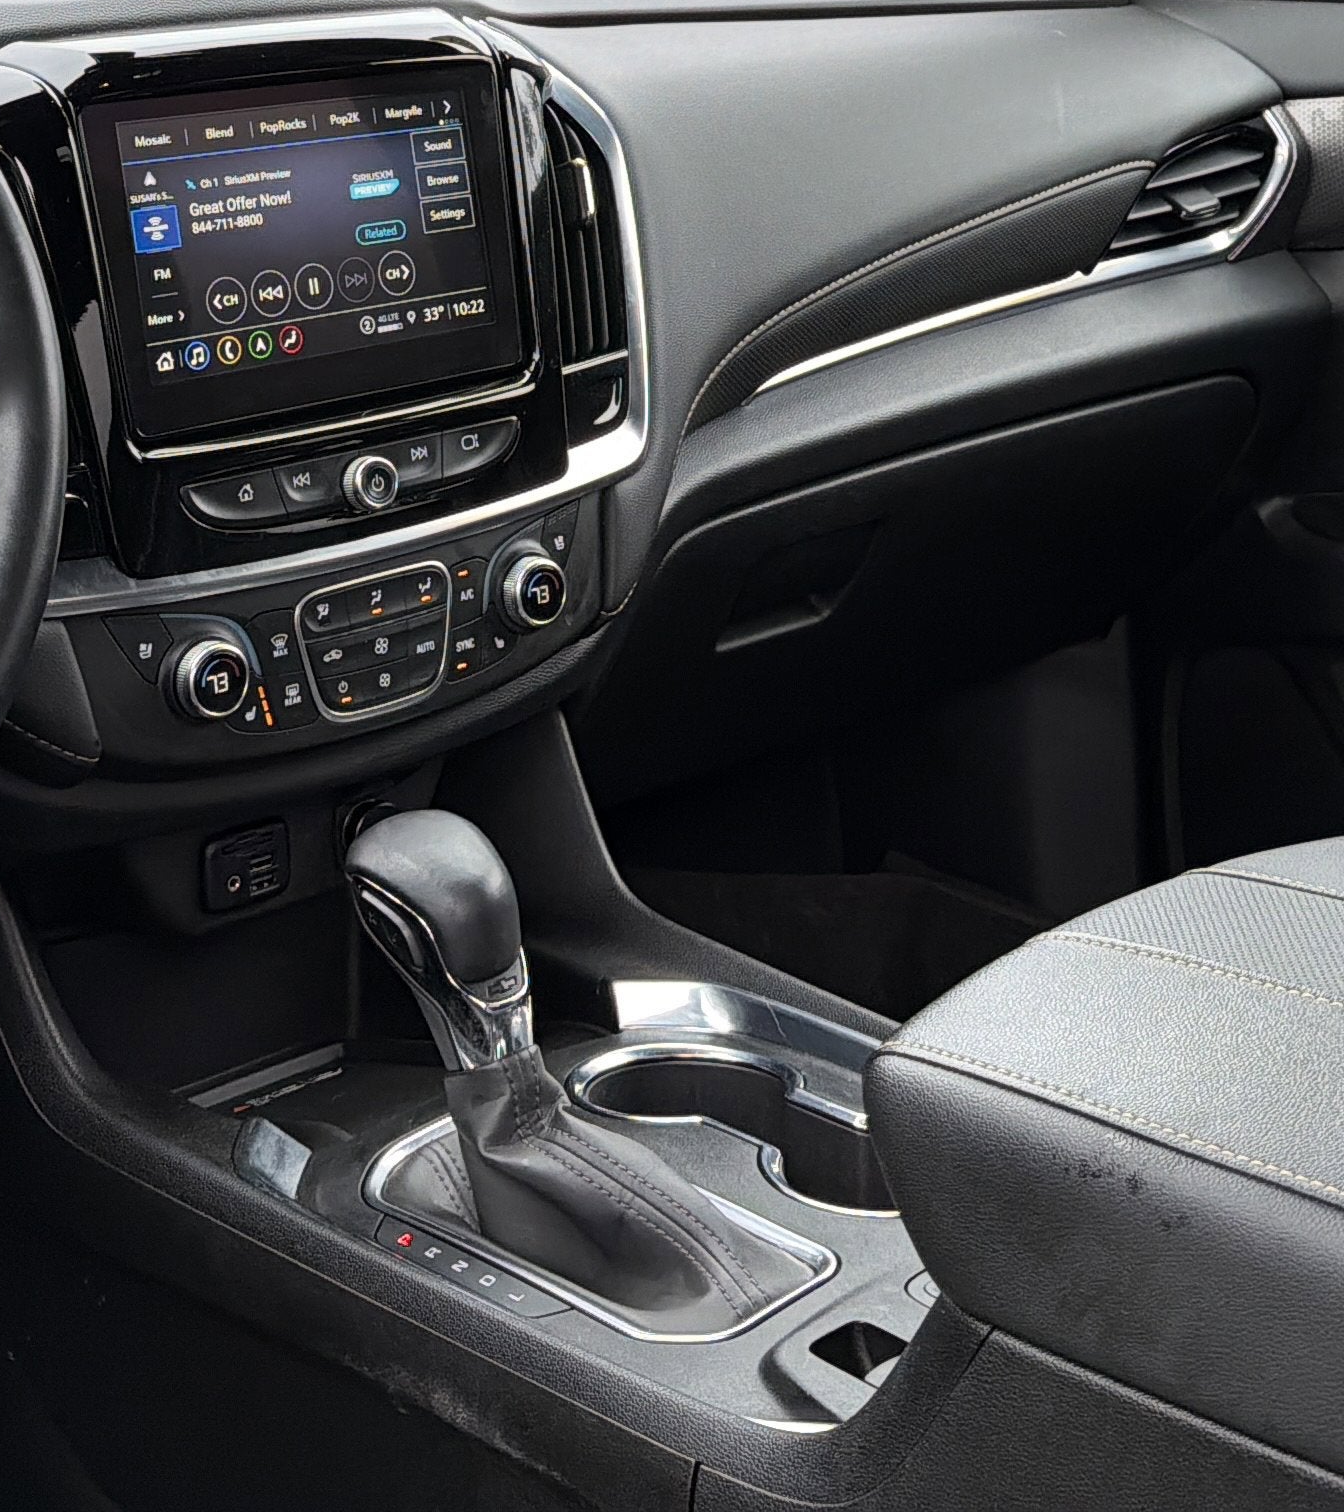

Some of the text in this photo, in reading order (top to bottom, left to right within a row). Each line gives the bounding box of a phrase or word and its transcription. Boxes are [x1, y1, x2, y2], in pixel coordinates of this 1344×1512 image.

[134, 134, 172, 148] Mosaic
[205, 125, 234, 140] Blend
[259, 118, 308, 135] PopRocks
[329, 111, 361, 127] Pop2K
[424, 139, 453, 153] Sound
[200, 178, 212, 189] Ch
[224, 171, 260, 186] SiriusXM
[260, 170, 292, 182] Preview
[351, 169, 394, 184] SIRIUSXM
[426, 173, 460, 188] Browse
[189, 190, 293, 217] Great Offer Now!
[429, 207, 466, 223] Settings
[191, 212, 264, 235] 844-711-8800
[364, 225, 398, 240] Related
[153, 268, 172, 281] FM
[385, 268, 400, 280] CH
[223, 293, 239, 307] CH
[452, 299, 485, 317] 10:22
[147, 314, 174, 327] More
[460, 588, 475, 602] A/C
[531, 584, 550, 605] 73
[416, 640, 436, 655] AUTO
[456, 637, 476, 653] SYNC
[206, 671, 229, 694] 73
[424, 1246, 442, 1259] R
[450, 1259, 469, 1273] N
